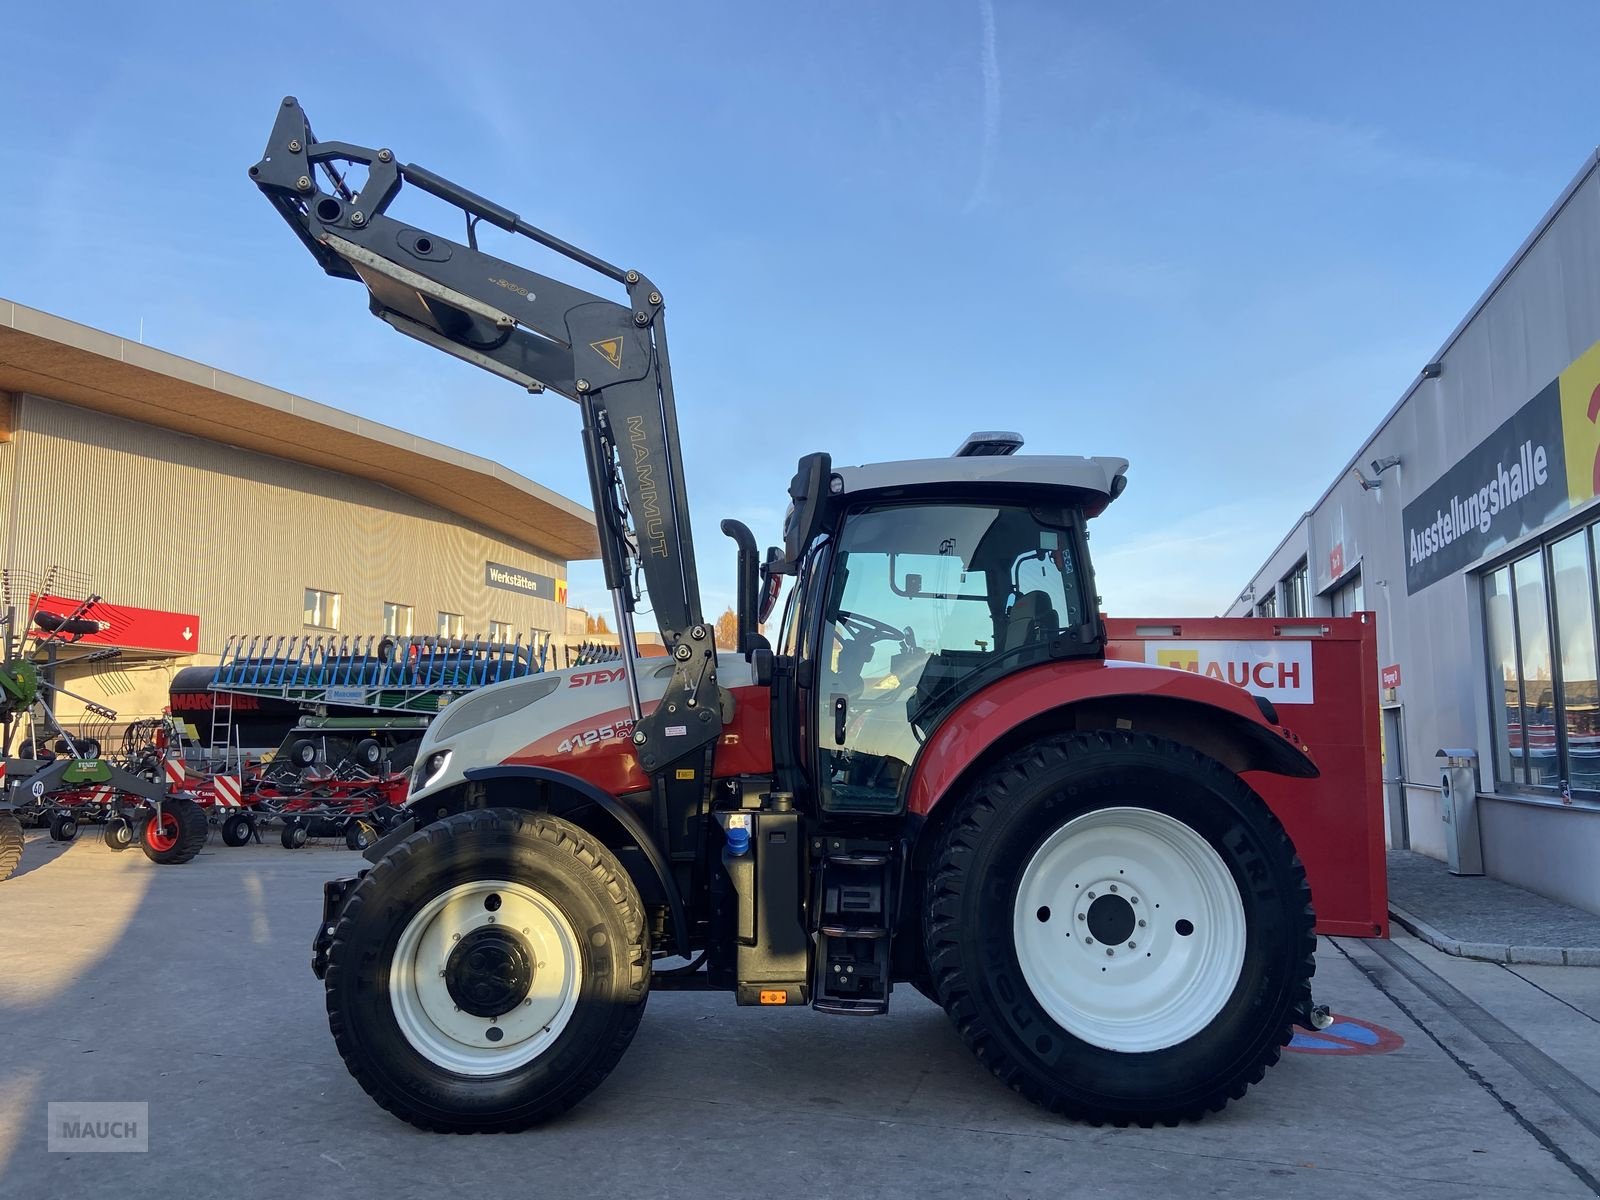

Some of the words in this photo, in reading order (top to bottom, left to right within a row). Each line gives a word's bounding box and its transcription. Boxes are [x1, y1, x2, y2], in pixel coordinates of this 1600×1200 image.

[626, 414, 669, 559] MAMMUT
[1409, 440, 1549, 567] Ausstellungshalle
[489, 567, 537, 591] Werkstätten
[557, 725, 615, 754] 4125
[33, 783, 42, 795] 40
